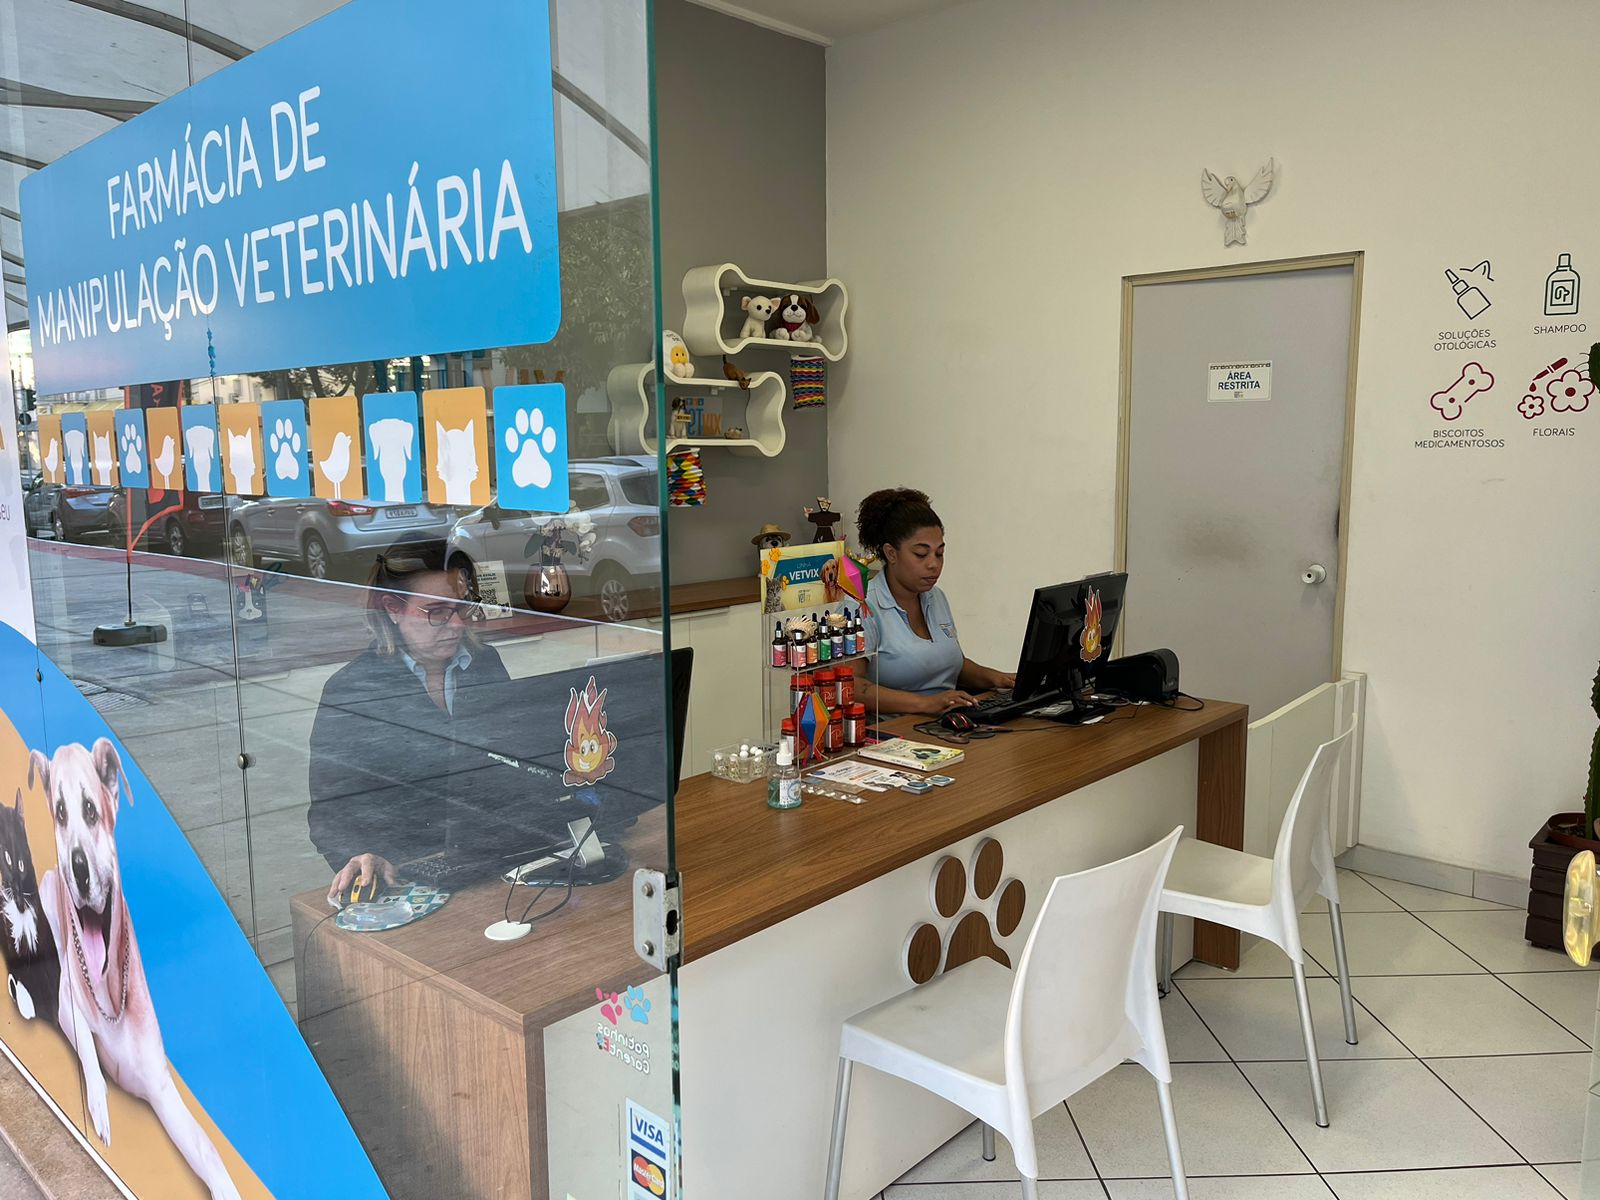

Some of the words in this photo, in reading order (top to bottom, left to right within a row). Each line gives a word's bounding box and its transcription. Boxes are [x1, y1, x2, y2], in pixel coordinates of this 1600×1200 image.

[107, 116, 262, 240] FARMÁCIA
[270, 85, 326, 182] DE
[36, 238, 219, 348] MANIPULAÇÃO
[225, 159, 533, 308] VETERINÁRIA
[1438, 328, 1491, 341] SOLUÇÕES
[1533, 324, 1587, 335] SHAMPOO
[1433, 340, 1497, 352] OTOLÓGICAS
[1227, 371, 1251, 380] ÁREA
[1218, 381, 1260, 390] RESTRITA
[1433, 429, 1484, 438] BISCOITOS
[1532, 428, 1576, 437] FLORAIS
[1414, 439, 1505, 449] MEDICAMENTOSOS
[789, 569, 818, 581] VETVIX
[635, 1116, 664, 1146] VISA
